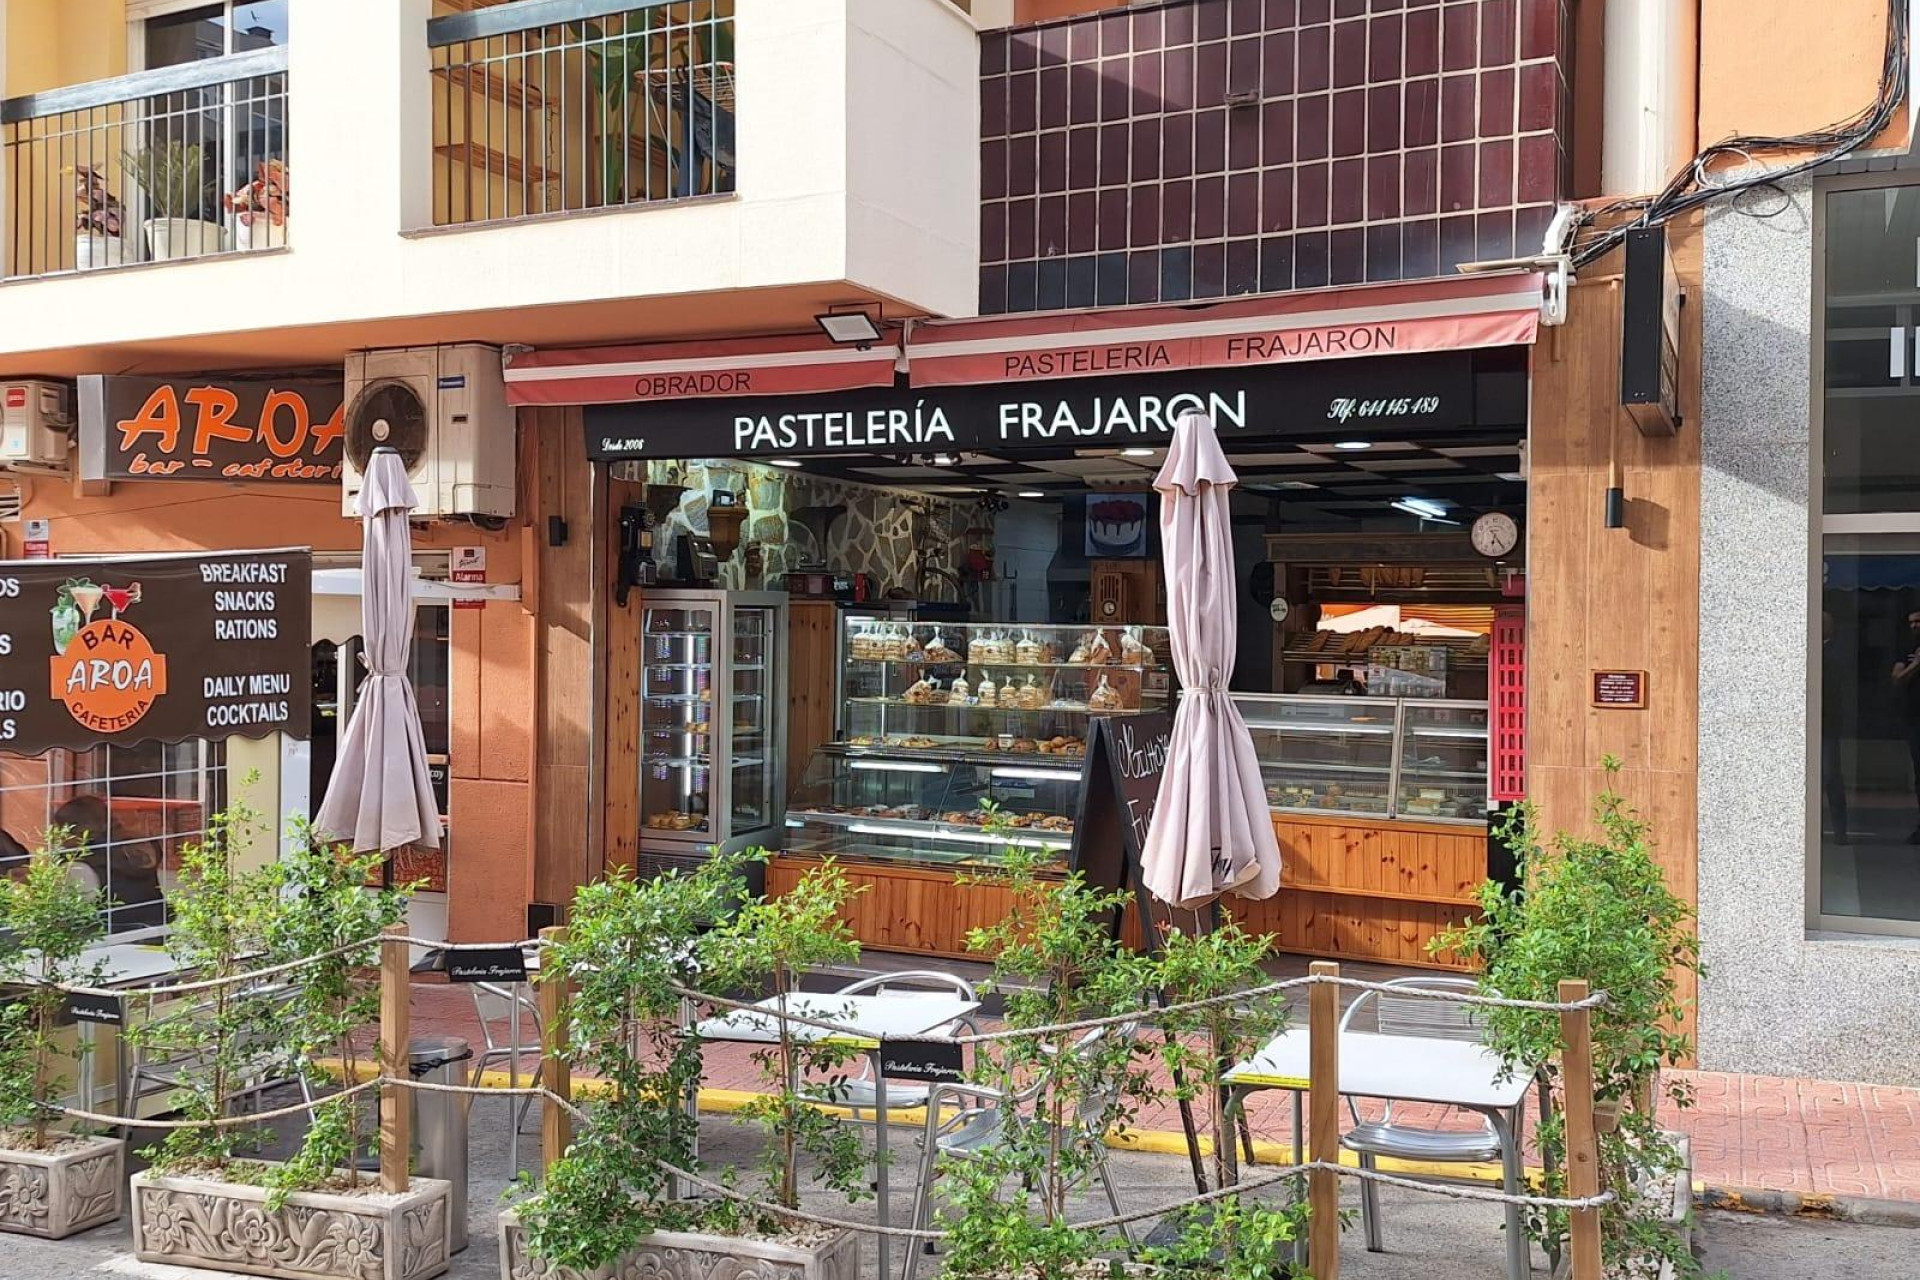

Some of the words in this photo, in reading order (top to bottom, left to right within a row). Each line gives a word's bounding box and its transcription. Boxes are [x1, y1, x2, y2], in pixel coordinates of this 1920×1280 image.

[1227, 325, 1396, 360] FRAJARON
[634, 373, 751, 397] OBRADOR
[733, 399, 955, 450] PASTELERÍA
[999, 390, 1247, 440] FRAJARON
[128, 453, 185, 474] bar
[221, 458, 344, 479] cafeteri
[200, 563, 288, 583] BREAKFAST
[455, 572, 484, 583] Alarma
[214, 591, 276, 612] SNACKS
[82, 624, 134, 650] BAR
[215, 619, 278, 640] RATIONS
[66, 659, 153, 694] AROA
[203, 676, 246, 698] DAILY
[249, 674, 290, 695] MENU
[71, 700, 149, 729] CAFETERIA
[207, 701, 288, 727] COCKTAILS
